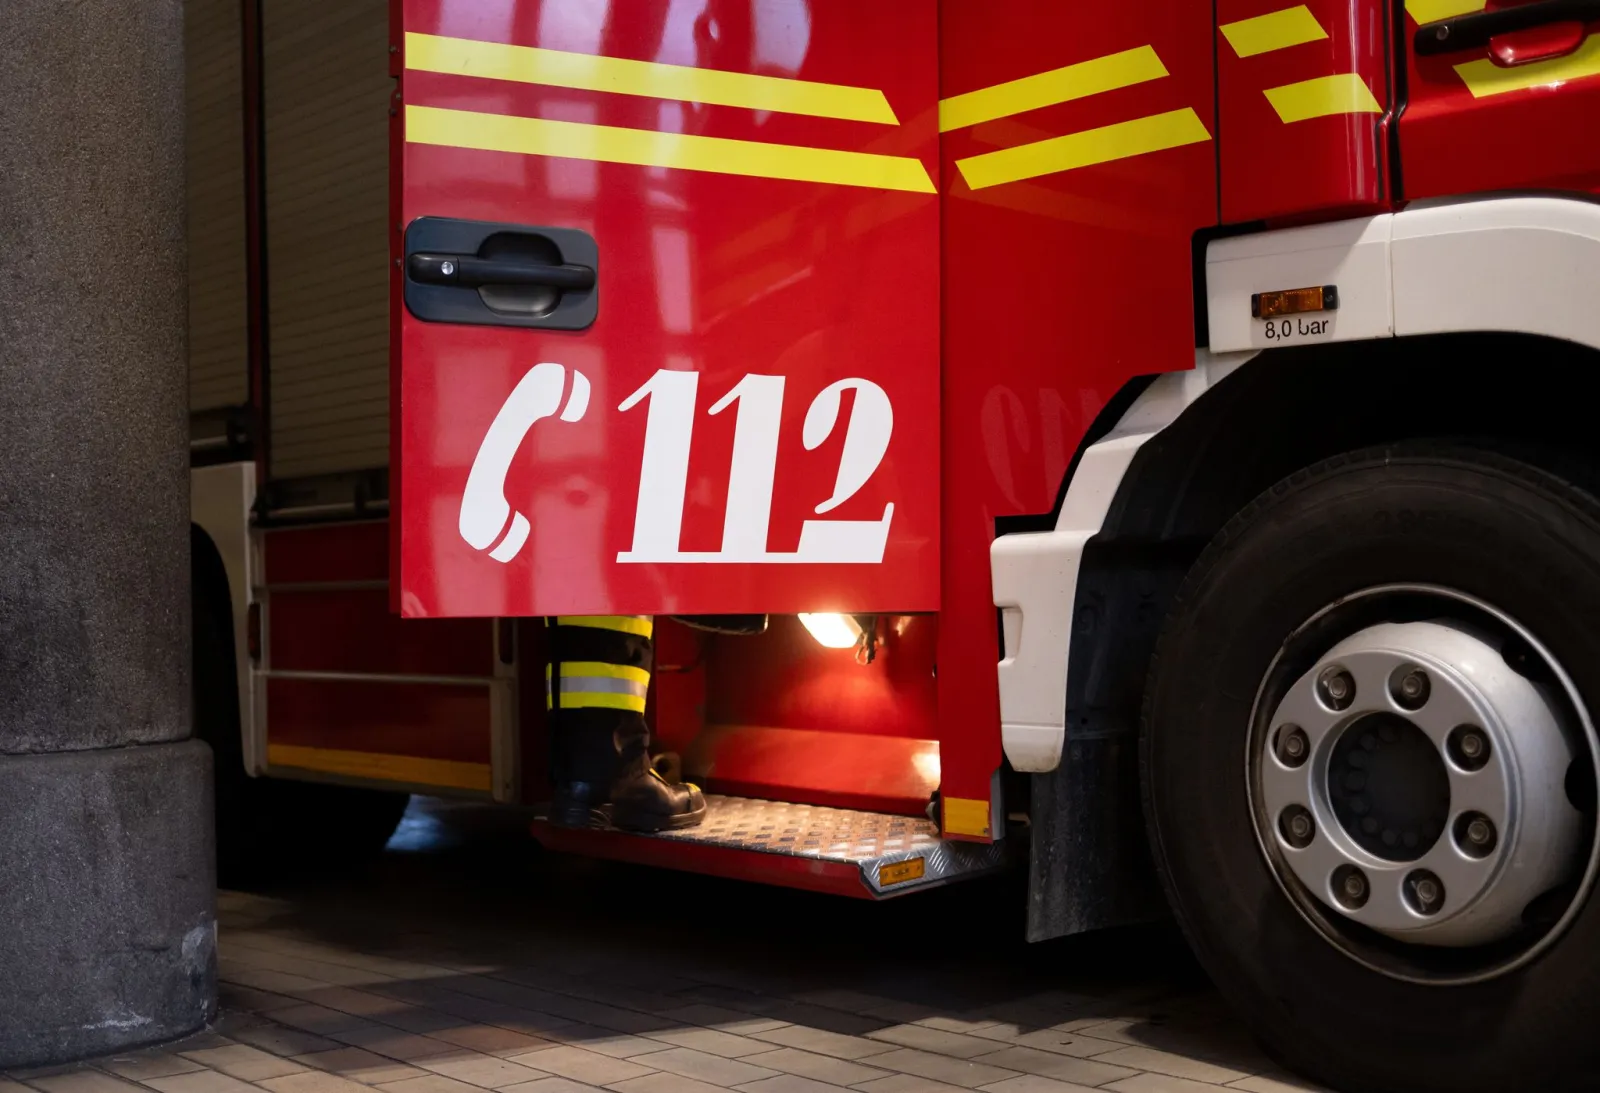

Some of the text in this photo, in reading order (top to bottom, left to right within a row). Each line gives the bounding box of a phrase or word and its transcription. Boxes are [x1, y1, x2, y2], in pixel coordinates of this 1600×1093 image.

[1265, 318, 1329, 341] 8,0 bar
[616, 368, 895, 564] 112
